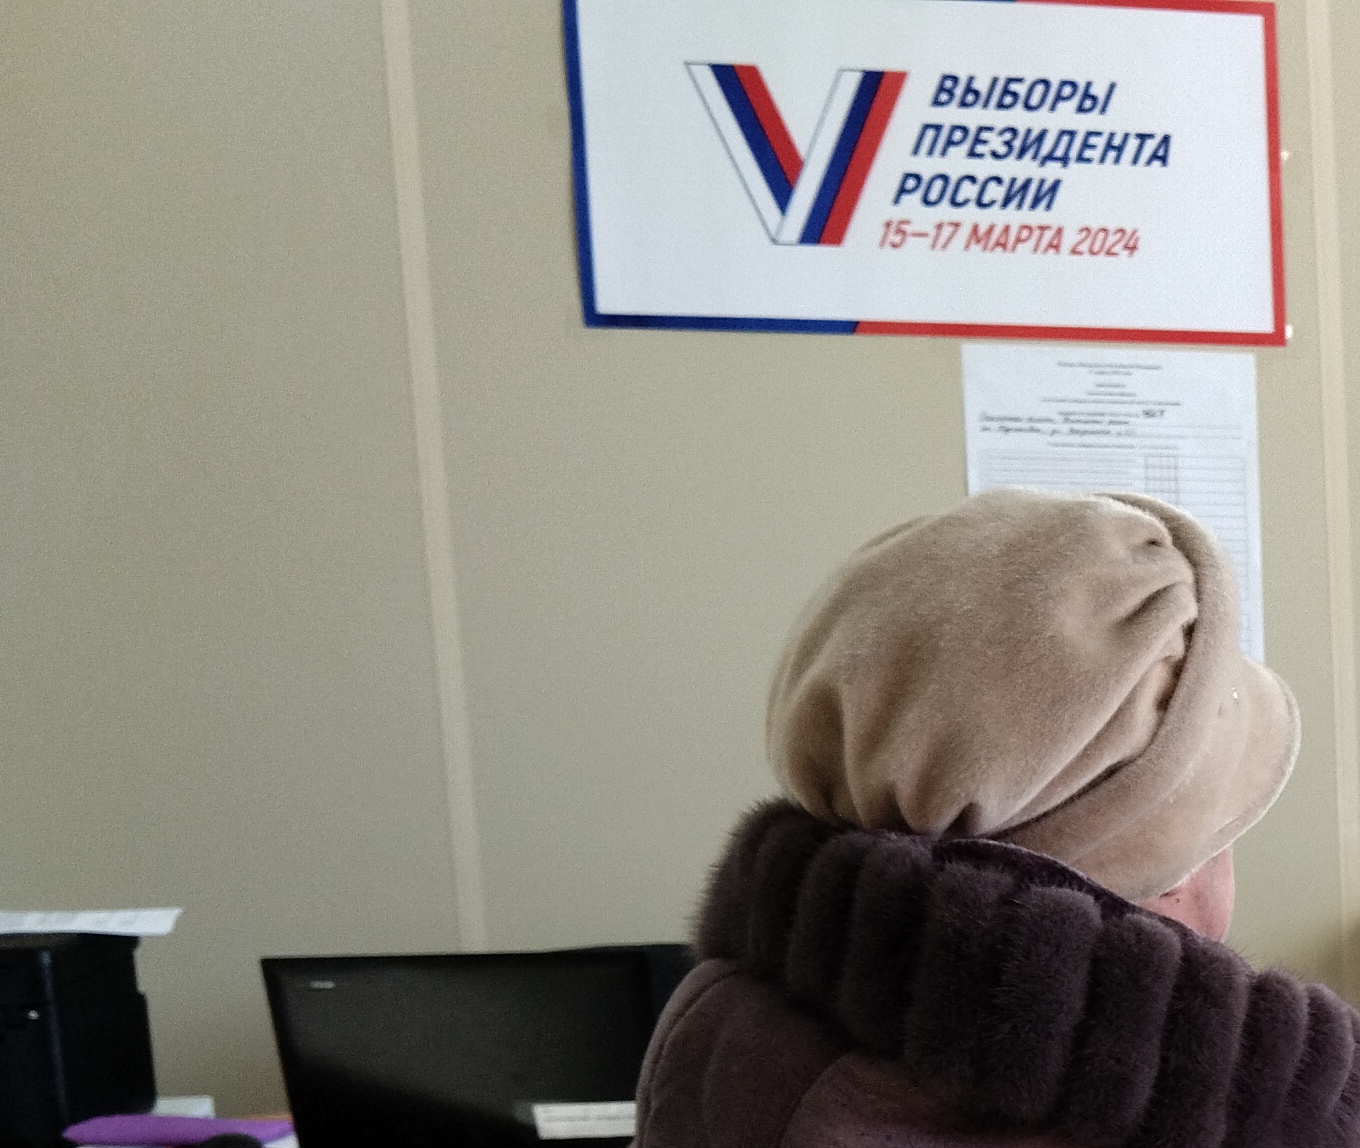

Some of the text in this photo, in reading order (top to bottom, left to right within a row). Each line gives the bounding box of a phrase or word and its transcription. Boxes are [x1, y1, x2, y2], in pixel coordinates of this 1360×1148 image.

[931, 73, 1117, 116] ВЫБОРЫ
[910, 122, 1172, 168] ПРЕЗИДЕНТА
[893, 172, 1063, 213] РОССИИ
[878, 219, 1140, 257] 15–17 МАРТА 2024
